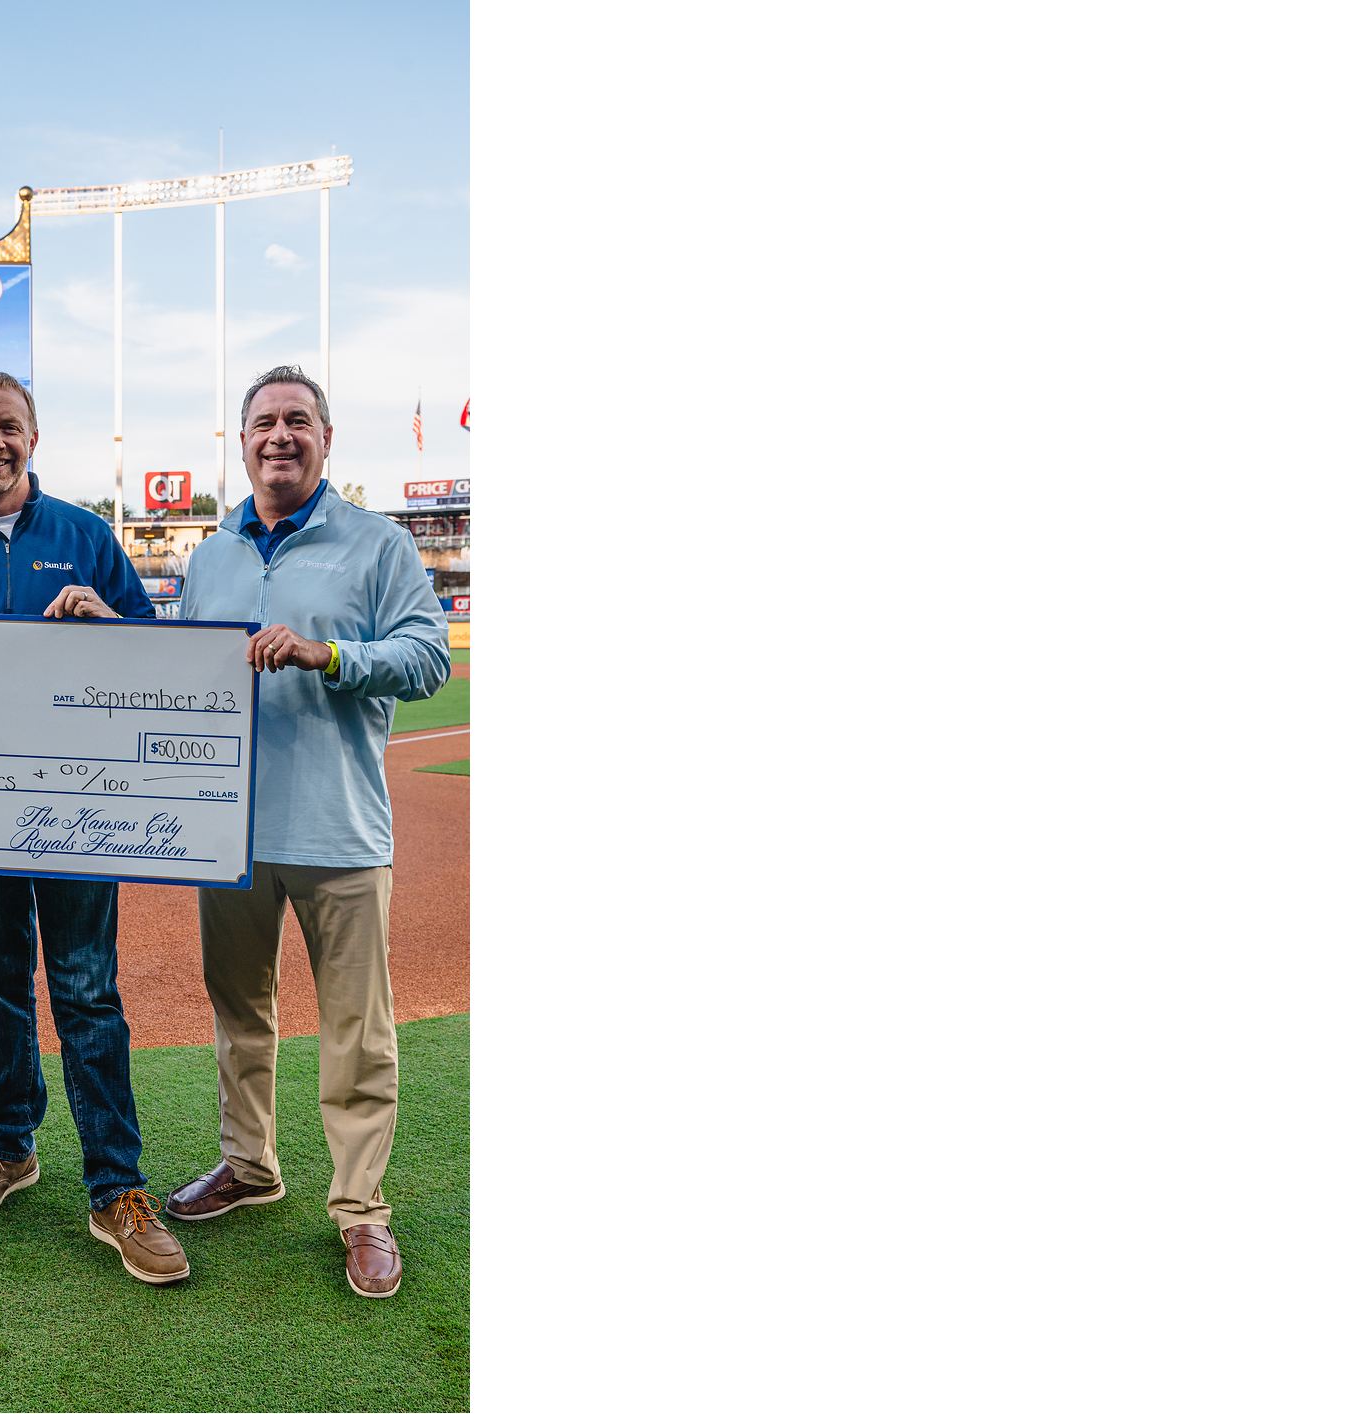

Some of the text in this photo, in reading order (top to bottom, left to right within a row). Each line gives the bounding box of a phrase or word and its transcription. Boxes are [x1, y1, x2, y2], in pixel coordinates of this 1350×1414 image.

[148, 475, 186, 504] QT
[408, 482, 448, 496] PRICE
[44, 561, 73, 570] Sun Life
[53, 694, 75, 703] DATE
[82, 685, 236, 718] September 23
[198, 790, 239, 799] DOLLARS
[16, 805, 183, 843] The Kansas City
[9, 827, 189, 859] Royals Foundation
